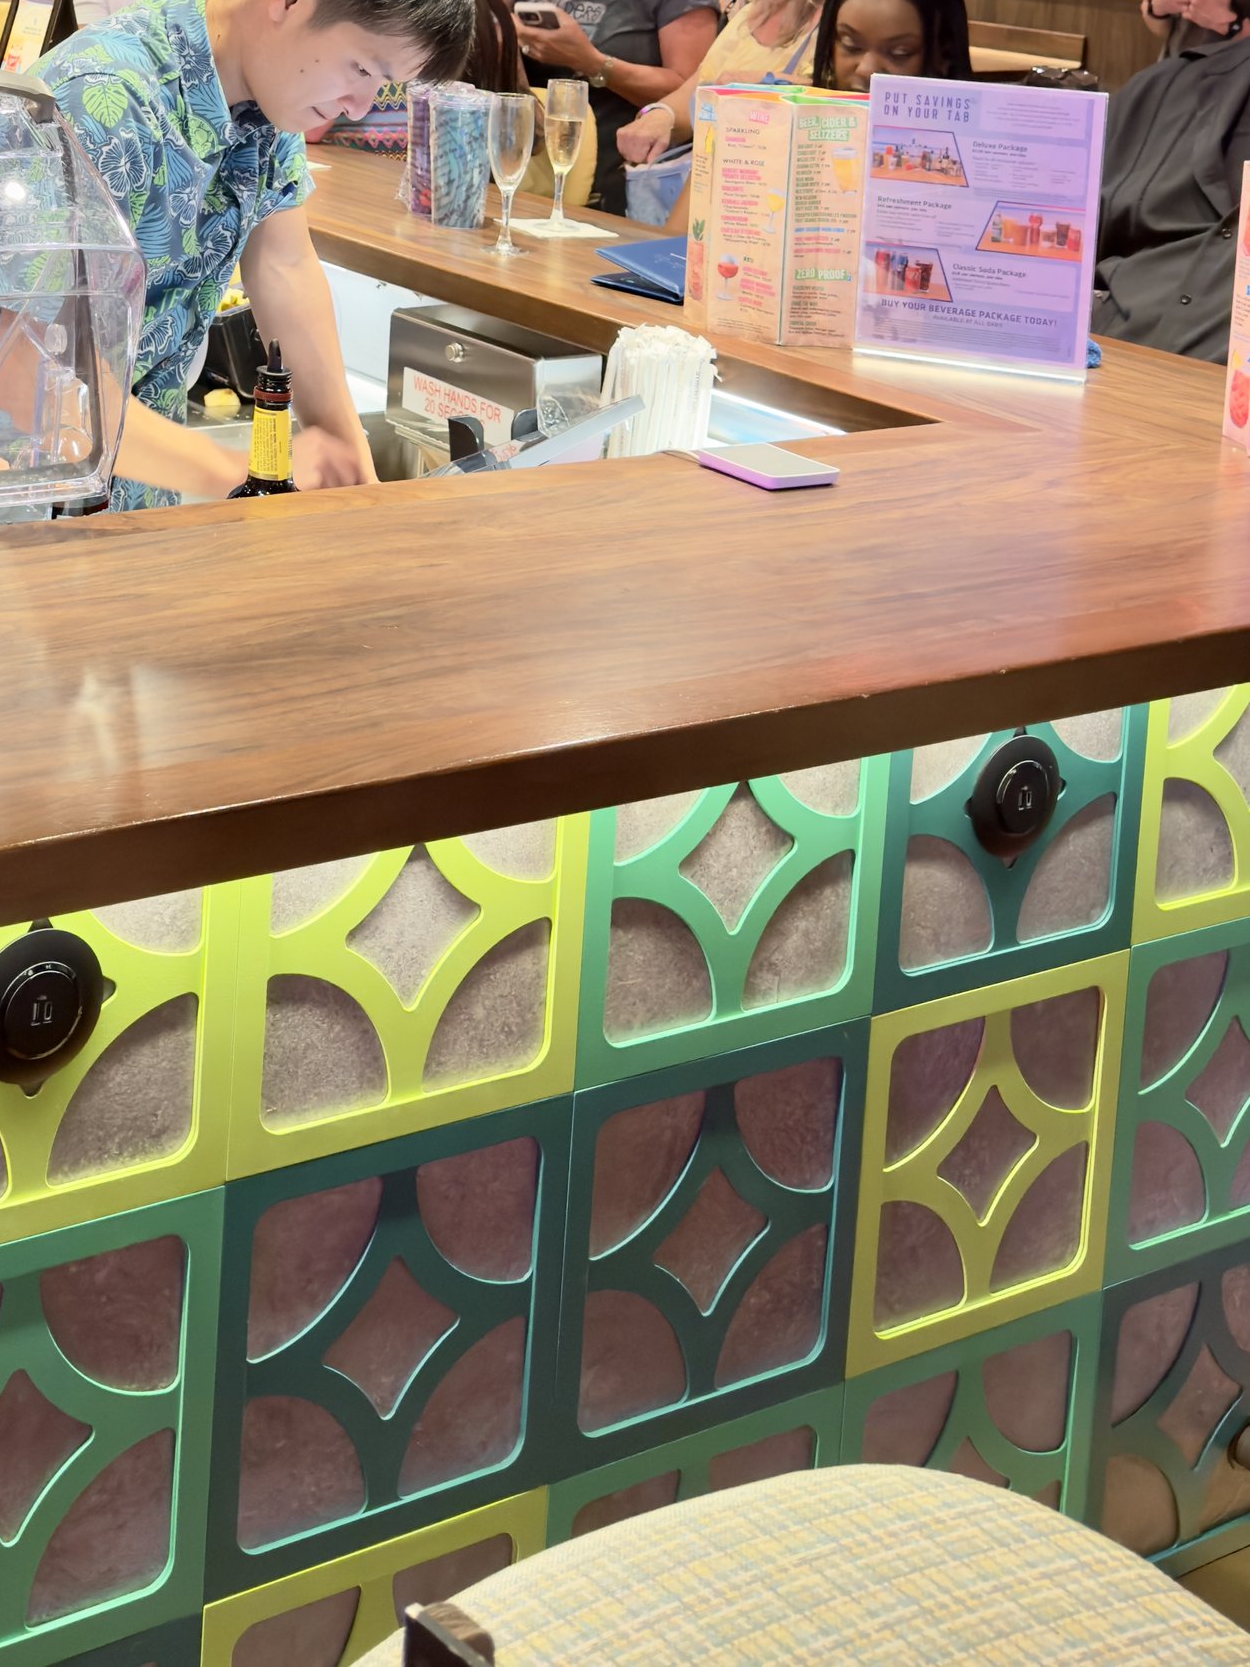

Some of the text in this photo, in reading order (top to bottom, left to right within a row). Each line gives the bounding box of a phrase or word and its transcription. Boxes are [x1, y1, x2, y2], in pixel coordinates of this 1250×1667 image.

[885, 91, 908, 105] PUT
[916, 94, 971, 111] SAVINGS
[749, 110, 770, 124] WINE
[883, 105, 970, 123] ON YOUR TAB
[821, 116, 848, 128] CIDER
[808, 129, 849, 141] SELTZERS
[998, 142, 1029, 154] Package
[877, 196, 952, 210] Refreshment Package
[796, 269, 846, 280] ZERO PROOF
[952, 263, 1027, 278] Classic Soda Package
[881, 298, 1058, 327] BUY YOUR BEVERAGE PACKAGE TODAY!
[413, 375, 502, 424] WASH HANDS FOR
[424, 398, 435, 414] 20
